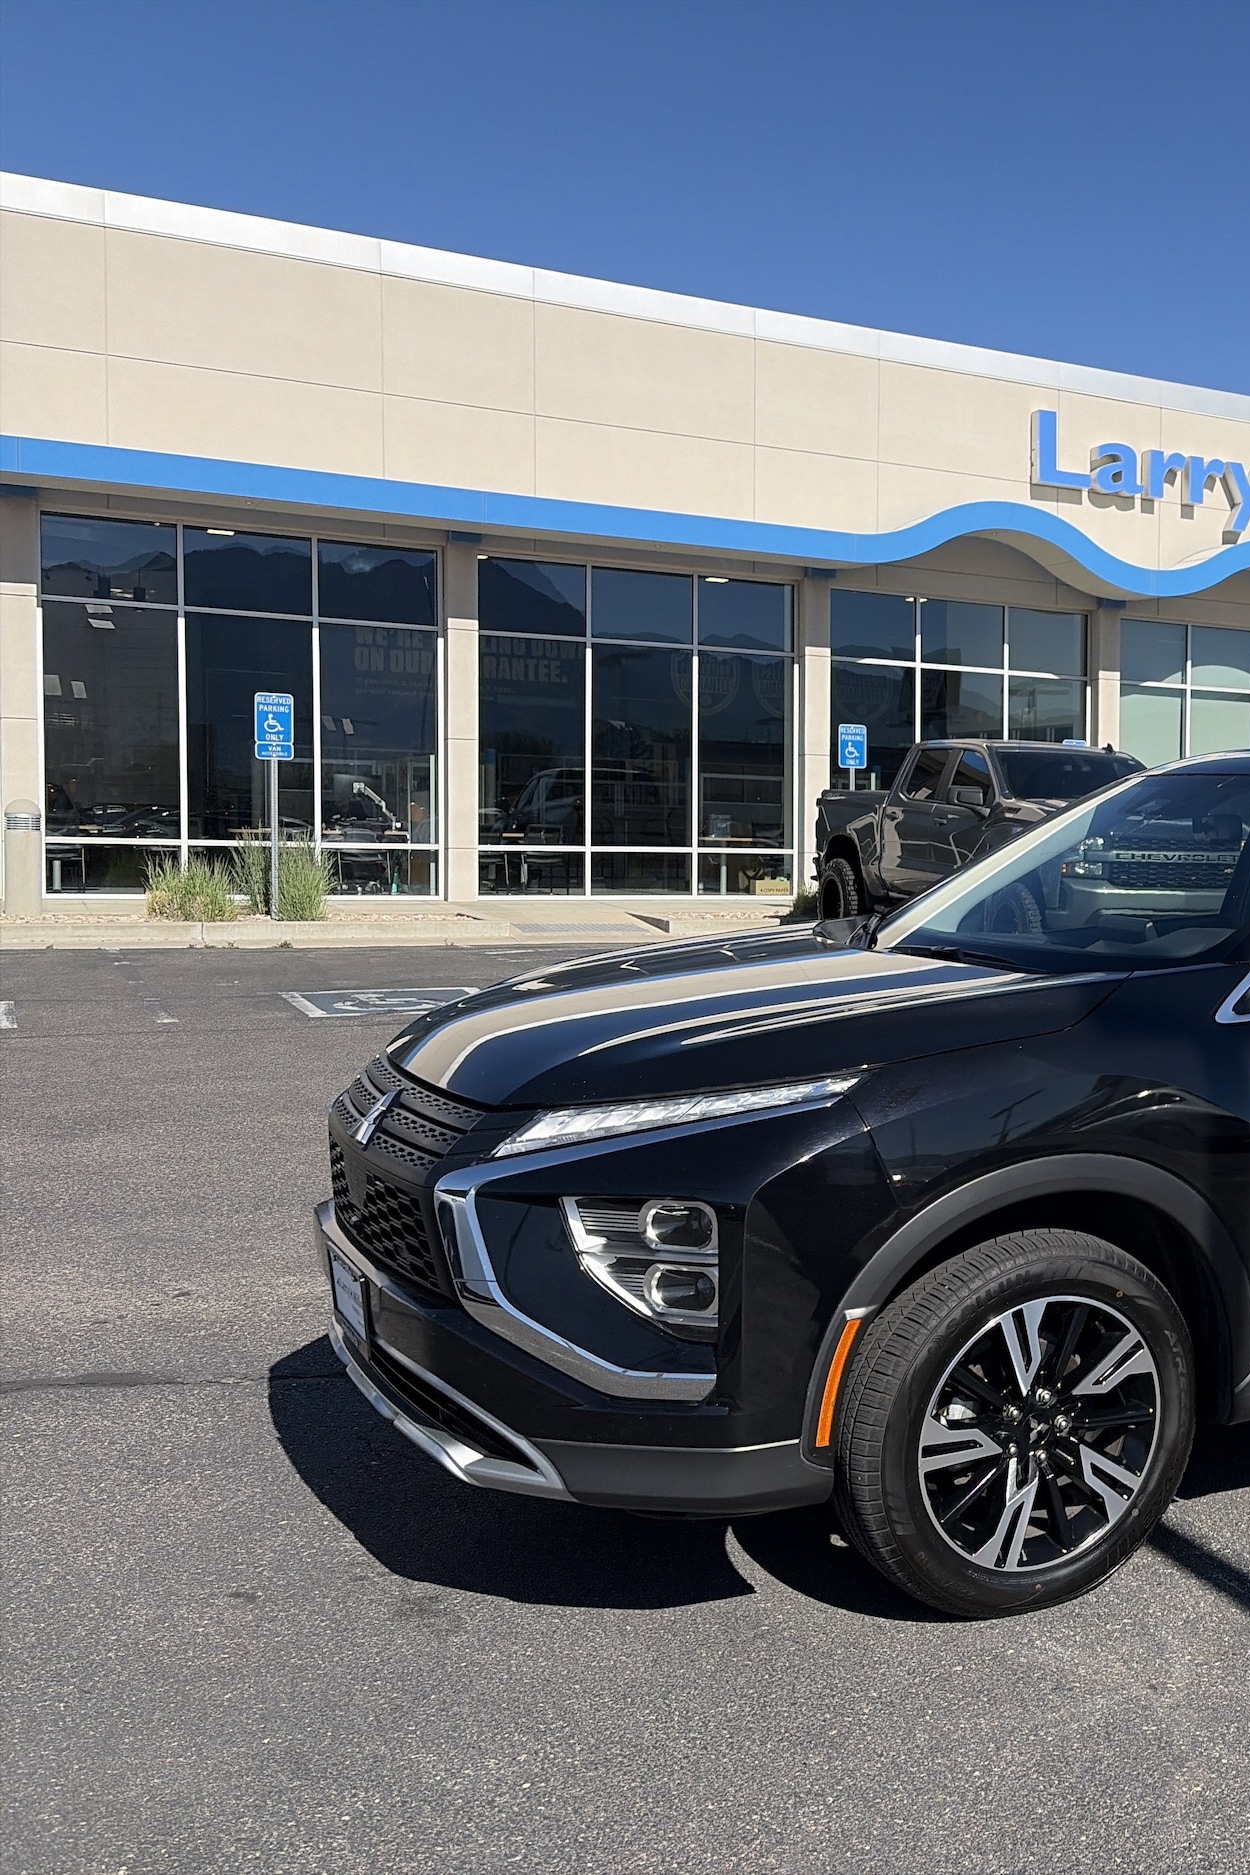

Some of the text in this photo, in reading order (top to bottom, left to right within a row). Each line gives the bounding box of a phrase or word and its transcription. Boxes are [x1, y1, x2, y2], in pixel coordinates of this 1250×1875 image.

[354, 646, 385, 672] ON
[256, 695, 292, 705] RESERVED
[259, 704, 290, 713] PARKING
[840, 726, 865, 735] RESERVED
[265, 733, 284, 741] ONLY
[845, 758, 861, 766] ONLY
[1115, 852, 1240, 863] CHEVROLET
